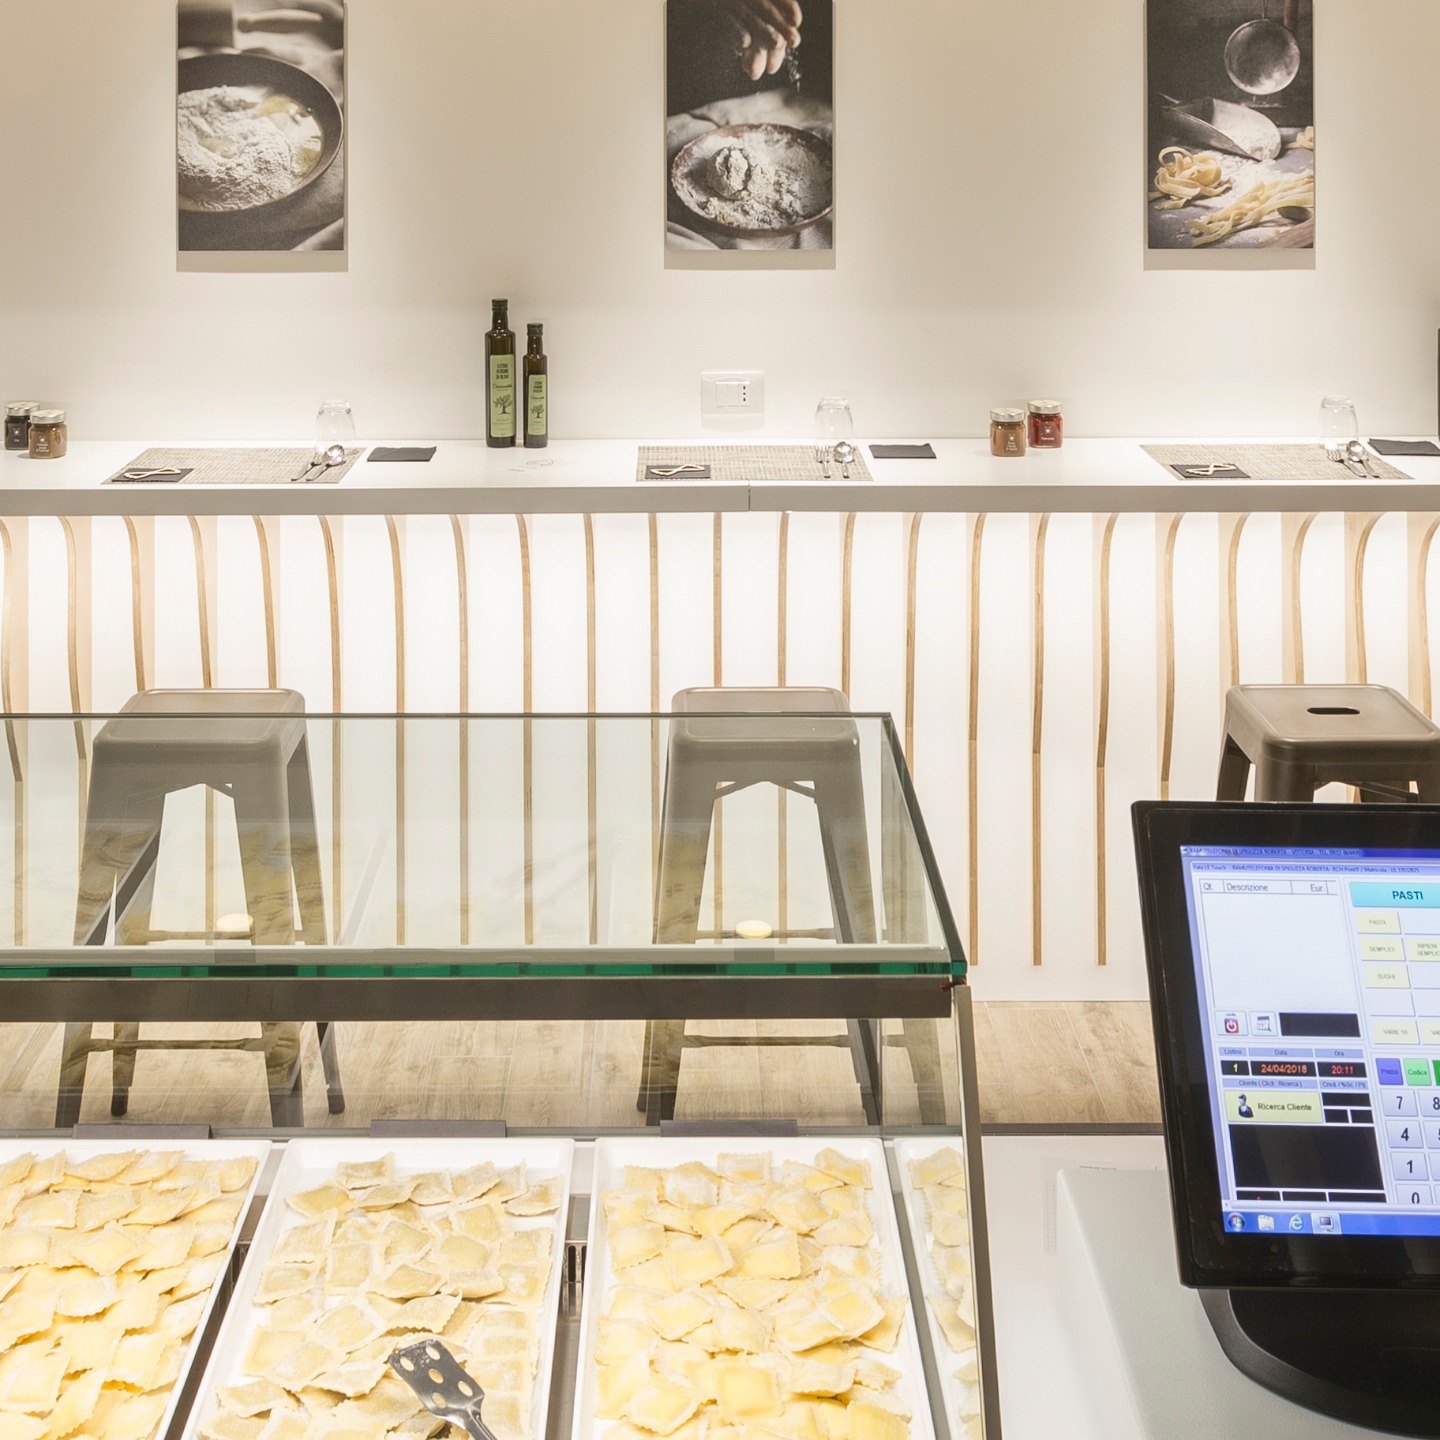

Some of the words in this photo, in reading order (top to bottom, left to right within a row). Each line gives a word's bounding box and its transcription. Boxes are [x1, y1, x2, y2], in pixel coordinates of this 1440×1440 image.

[1226, 882, 1269, 892] Descrizione
[1392, 890, 1424, 900] PASTI
[1232, 1064, 1238, 1073] 1
[1261, 1064, 1308, 1074] 24/04/2018
[1332, 1066, 1354, 1074] 20:11
[1408, 1068, 1428, 1076] Codice
[1258, 1102, 1286, 1111] Ricerca
[1286, 1103, 1312, 1111] Cliente
[1396, 1096, 1404, 1110] 7
[1432, 1096, 1440, 1110] 8
[1400, 1127, 1410, 1142] 4
[1406, 1160, 1414, 1174] 1
[1411, 1192, 1420, 1204] 0
